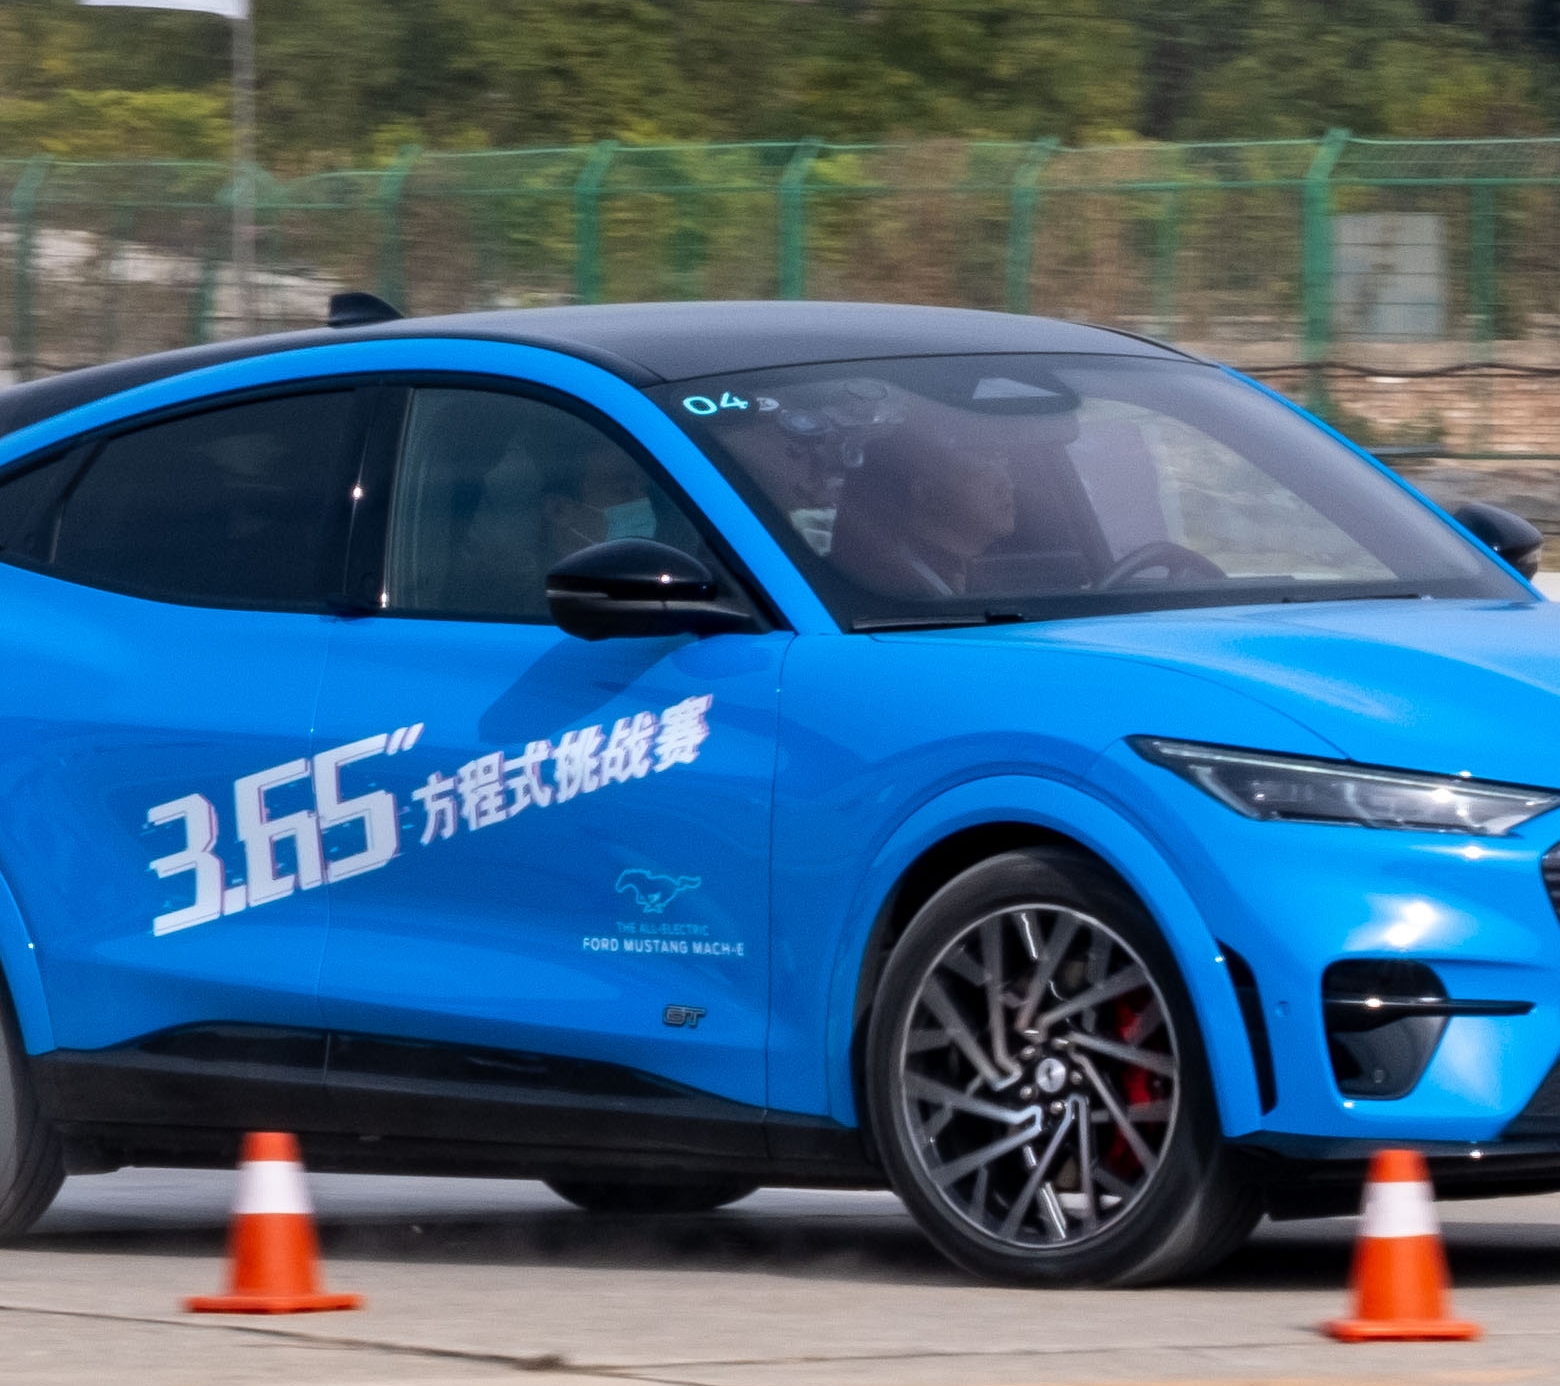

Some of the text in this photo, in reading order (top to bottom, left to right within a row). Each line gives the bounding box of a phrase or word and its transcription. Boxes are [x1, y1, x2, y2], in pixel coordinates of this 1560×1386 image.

[683, 391, 749, 415] 04
[412, 694, 714, 845] 方程式挑战赛
[582, 937, 745, 956] FORD MUSTANG MACH-E
[663, 1003, 707, 1028] GT
